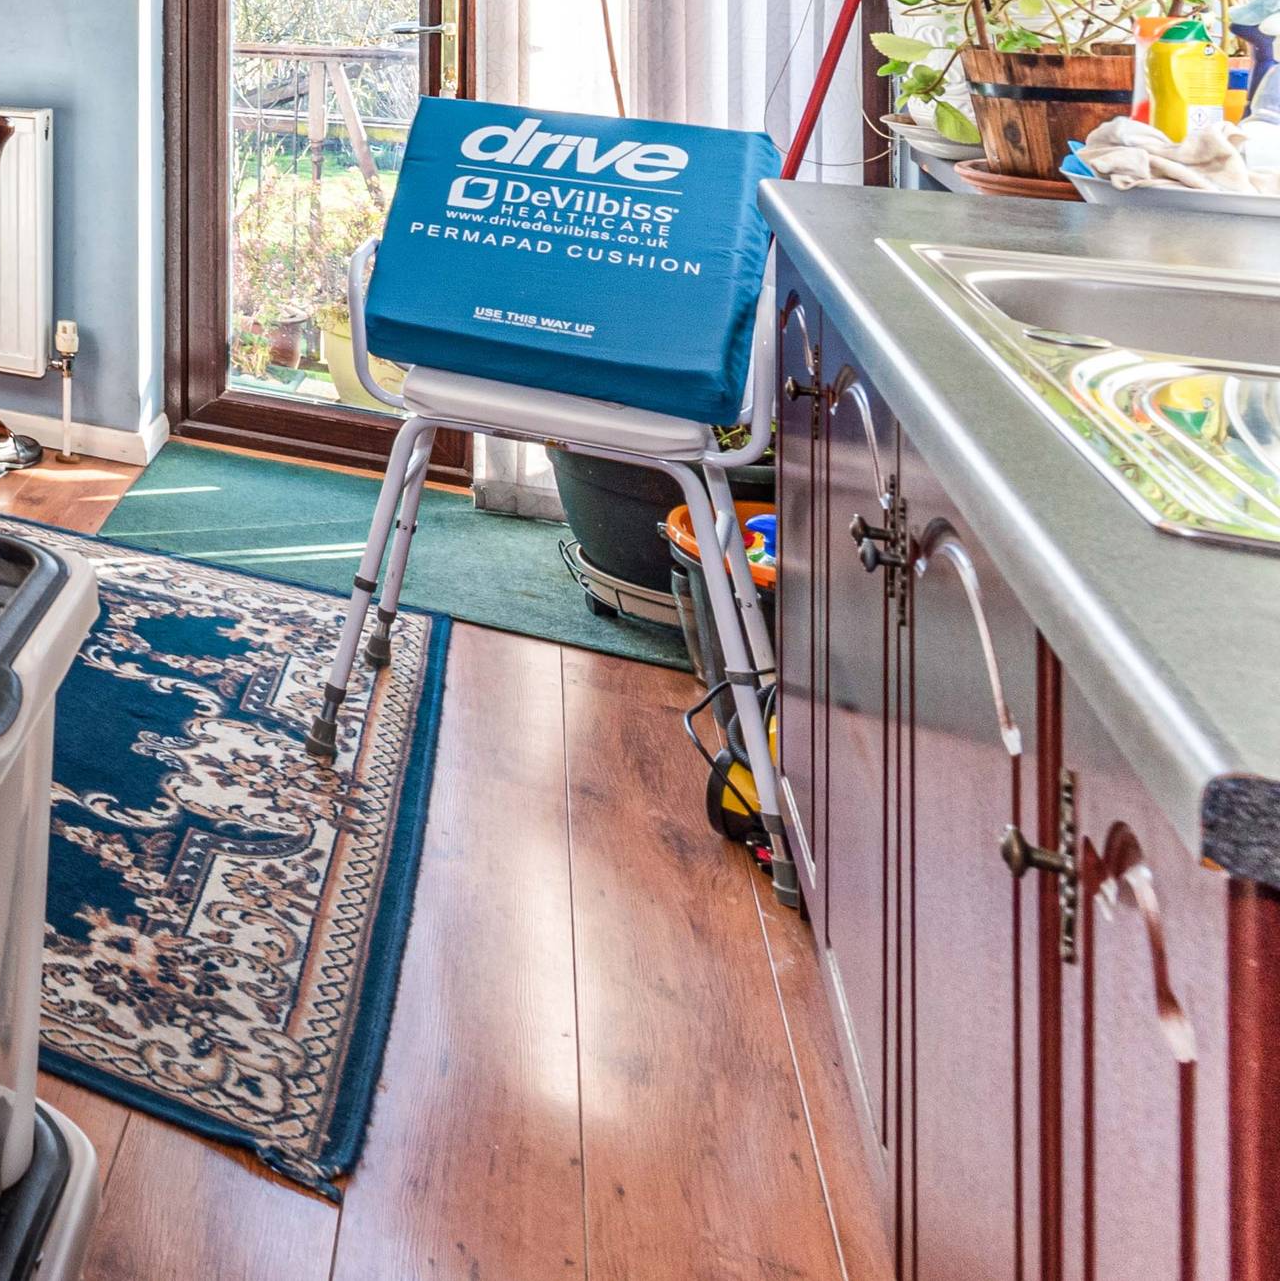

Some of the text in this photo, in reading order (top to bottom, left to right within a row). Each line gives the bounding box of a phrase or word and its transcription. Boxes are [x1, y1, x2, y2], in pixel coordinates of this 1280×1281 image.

[460, 118, 689, 182] drive
[501, 204, 670, 237] HEALTHCARE
[503, 180, 675, 223] DeVilbiss
[410, 221, 701, 276] PERMAPAD CUSHION
[446, 209, 668, 249] www.drivedevilbiss.co.uk
[475, 306, 595, 334] USE THIS WAY UP
